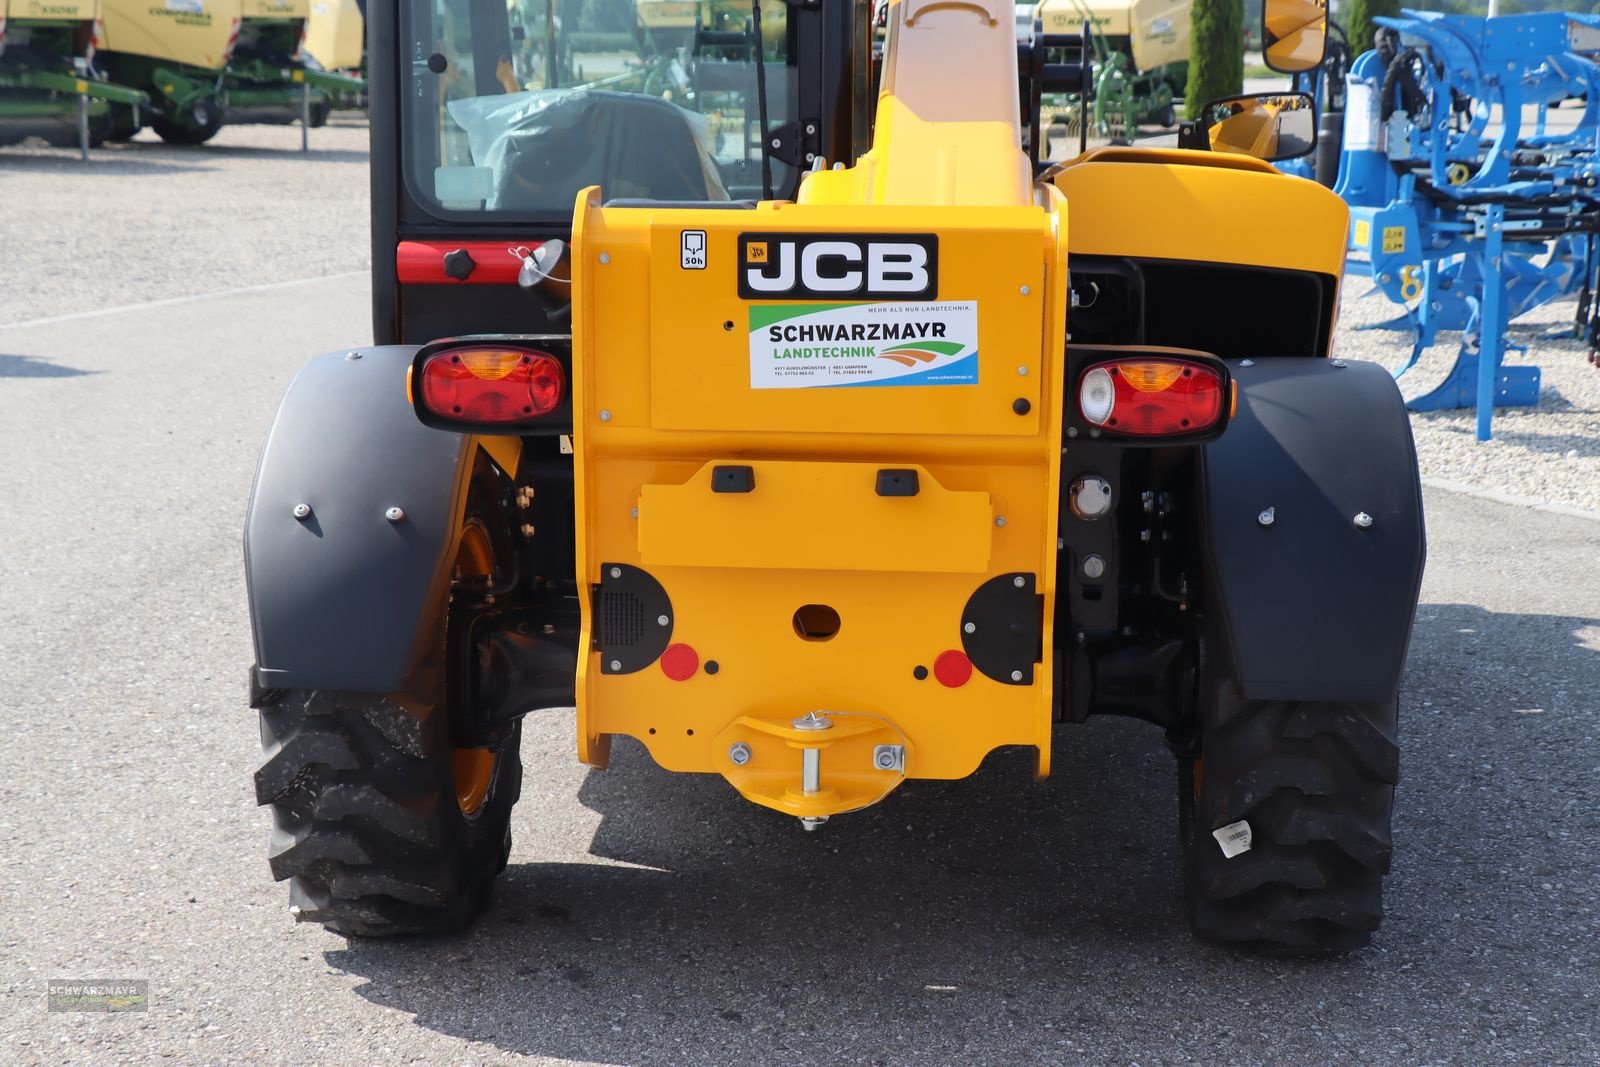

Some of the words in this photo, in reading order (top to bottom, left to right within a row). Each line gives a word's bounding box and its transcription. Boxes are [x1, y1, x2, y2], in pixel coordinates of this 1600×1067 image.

[685, 257, 703, 265] 50h
[747, 241, 929, 292] JCB
[769, 322, 946, 342] SCHWARZMAYR
[773, 346, 876, 359] LANDTECHNIK
